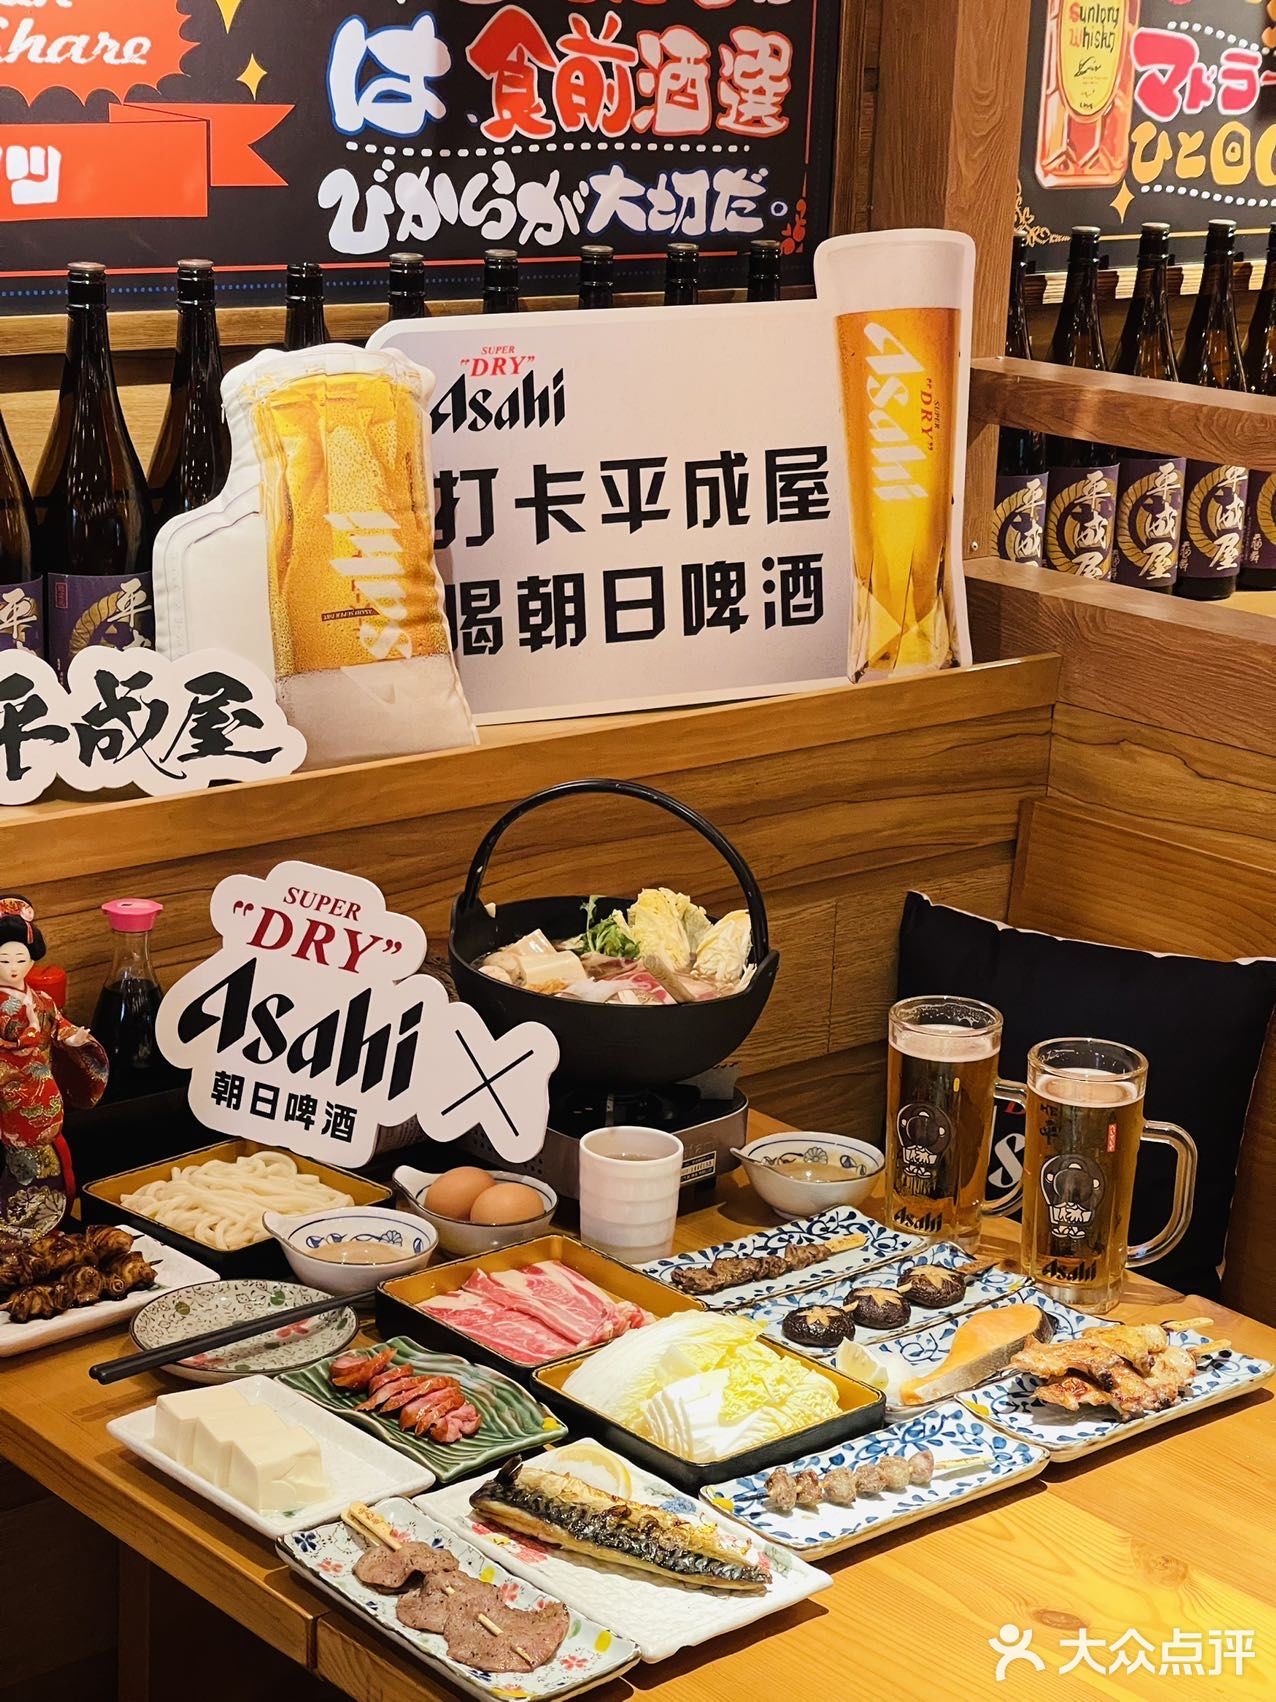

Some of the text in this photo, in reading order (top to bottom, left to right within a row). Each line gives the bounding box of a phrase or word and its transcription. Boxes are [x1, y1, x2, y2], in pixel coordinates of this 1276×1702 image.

[481, 345, 515, 355] SUPER
[430, 368, 566, 434] Asahi
[863, 323, 929, 500] Asahi
[433, 446, 831, 549] 打卡平成屋
[444, 553, 824, 656] 喝朝日啤酒
[283, 887, 361, 921] SUPER
[178, 957, 424, 1101] Asahi
[211, 1071, 358, 1143] 朝日啤酒
[894, 1206, 943, 1233] Asahi
[1041, 1257, 1097, 1282] Asahi
